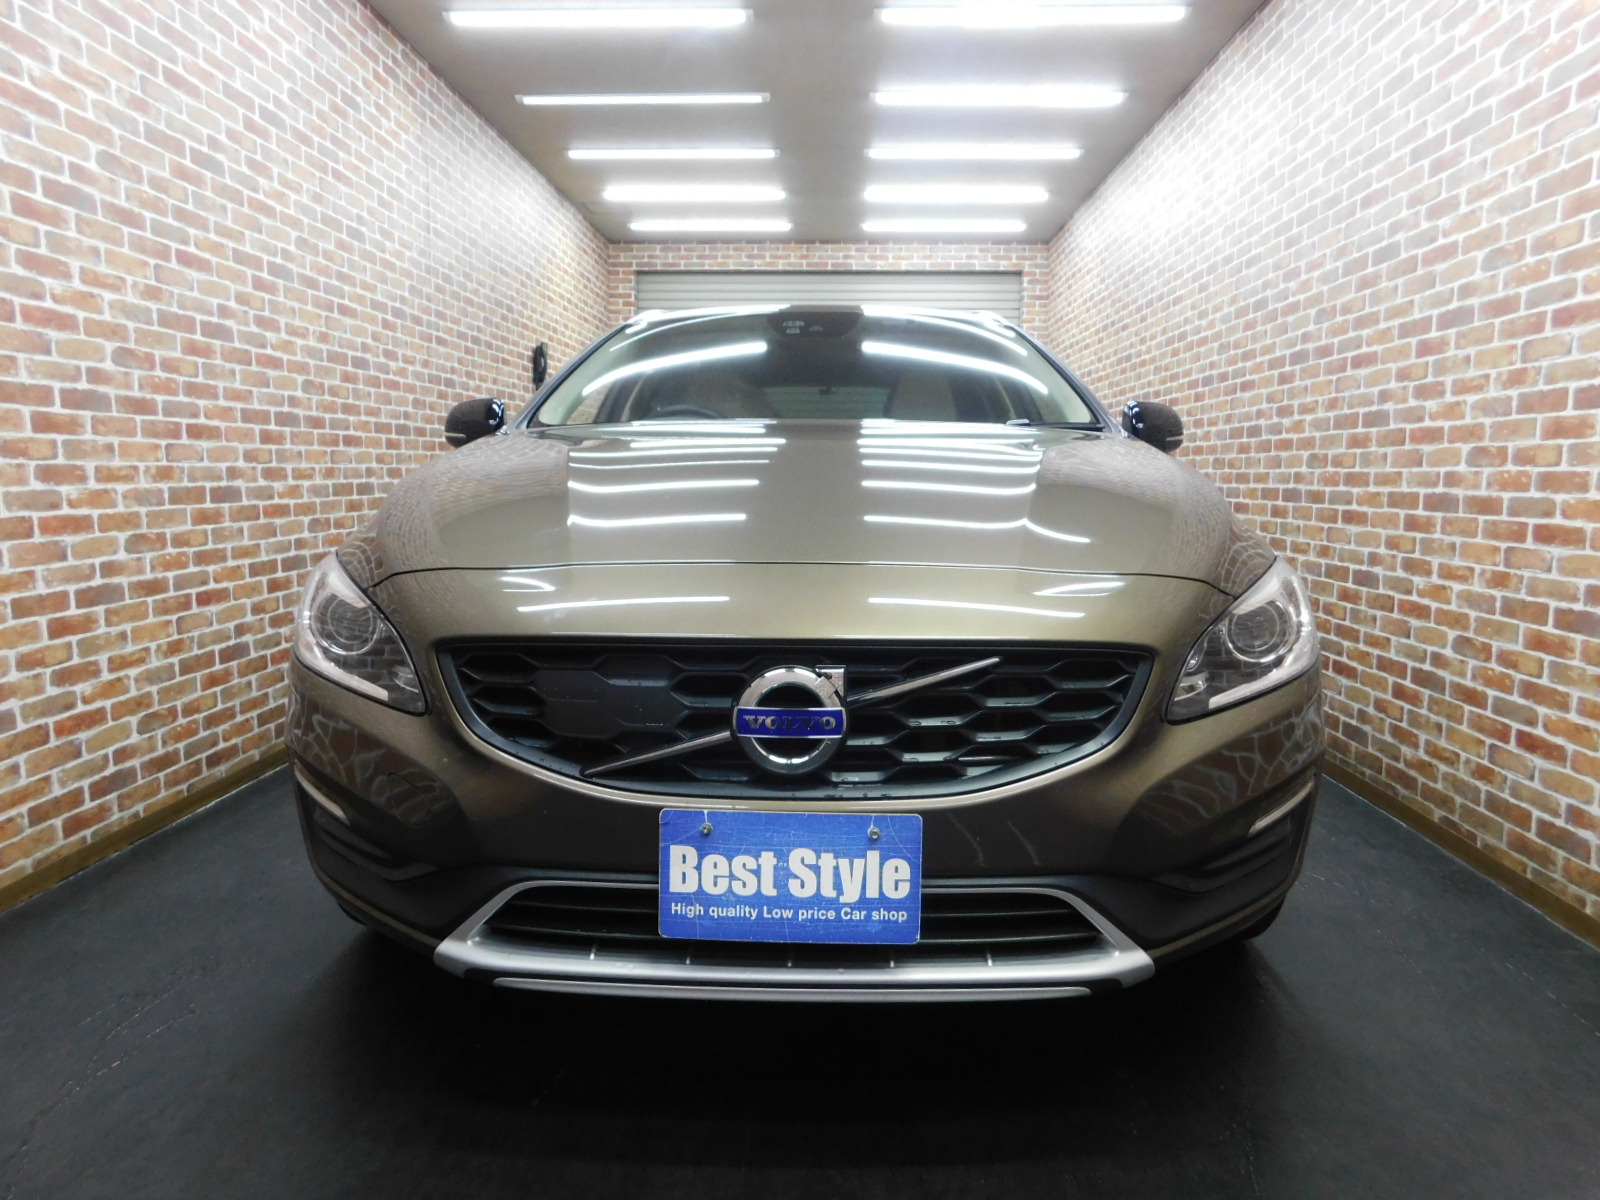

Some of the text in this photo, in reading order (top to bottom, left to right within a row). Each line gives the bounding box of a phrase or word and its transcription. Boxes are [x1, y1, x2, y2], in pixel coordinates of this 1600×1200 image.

[743, 715, 836, 730] VOLVO
[669, 844, 911, 904] Best Style
[671, 902, 908, 923] High quality Low price Car shop
